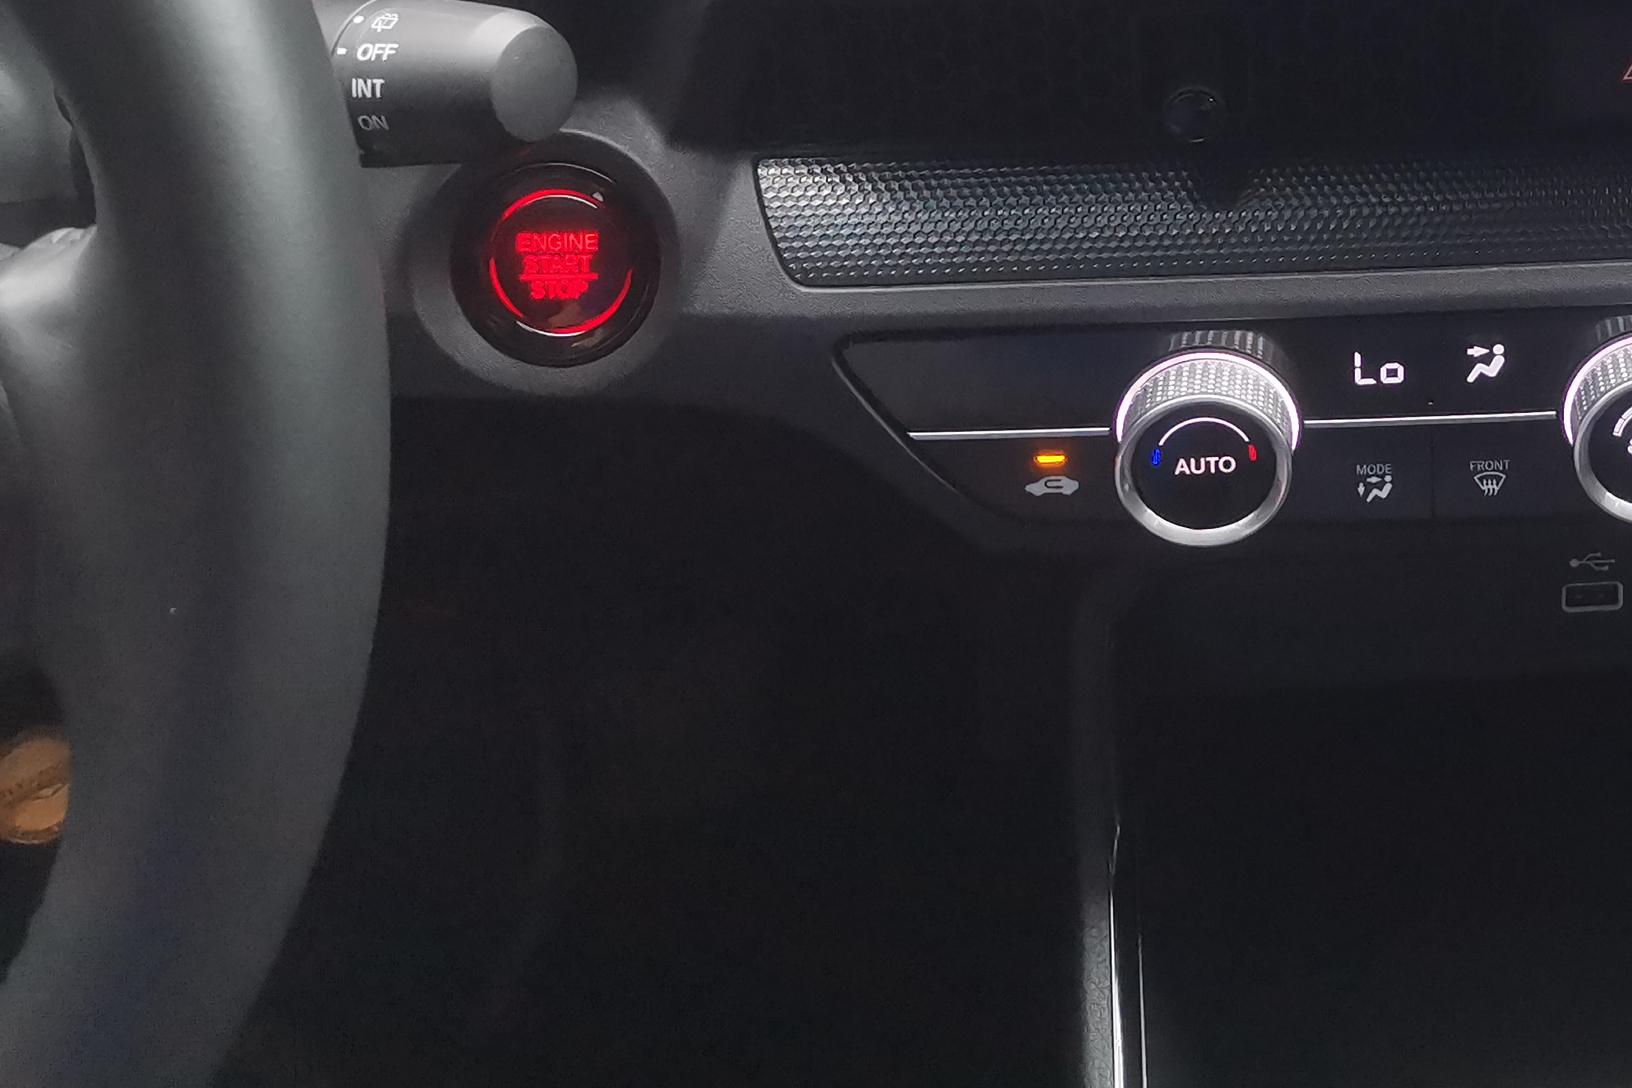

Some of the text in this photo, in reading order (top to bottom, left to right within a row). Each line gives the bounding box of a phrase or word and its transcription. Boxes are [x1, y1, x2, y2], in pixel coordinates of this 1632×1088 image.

[355, 43, 400, 62] OFF
[351, 77, 386, 99] INT
[357, 114, 390, 132] ON
[517, 233, 599, 252] ENGINE
[522, 254, 593, 274] START
[529, 279, 590, 301] STOP
[1354, 351, 1405, 386] Lo
[1174, 455, 1237, 476] AUTO
[1356, 463, 1393, 475] MODE
[1469, 459, 1511, 472] FRONT
